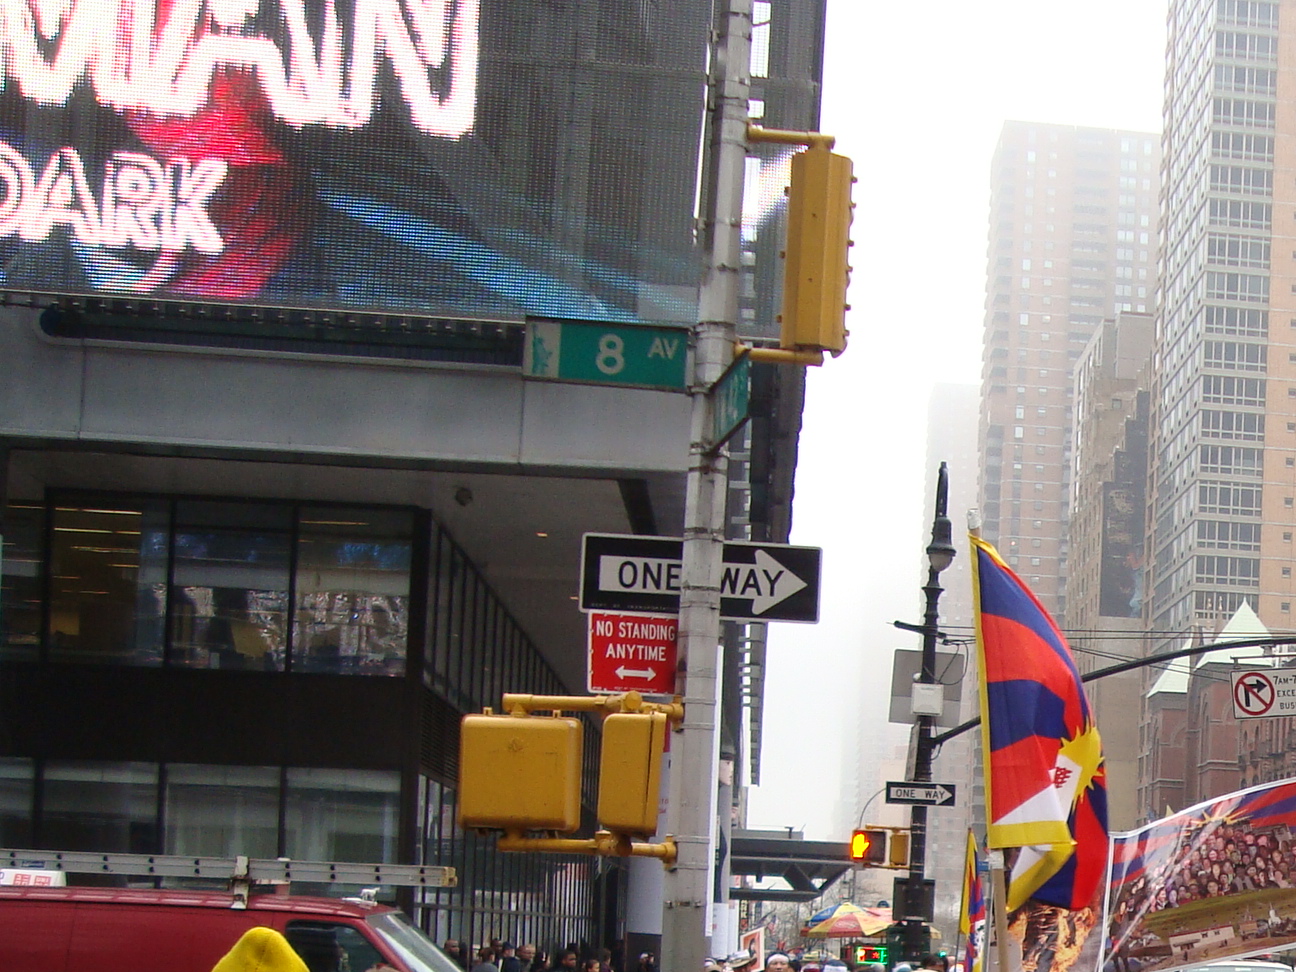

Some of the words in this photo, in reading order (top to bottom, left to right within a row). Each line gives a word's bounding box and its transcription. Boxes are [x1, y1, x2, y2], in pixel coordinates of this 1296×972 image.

[596, 334, 624, 375] 8
[647, 338, 679, 359] AV
[618, 561, 682, 592] ONE
[720, 567, 784, 597] WAY
[596, 620, 613, 637] NO
[618, 621, 675, 641] STANDING
[605, 643, 666, 661] ANYTIME
[895, 788, 916, 799] ONE
[924, 790, 946, 799] WAY
